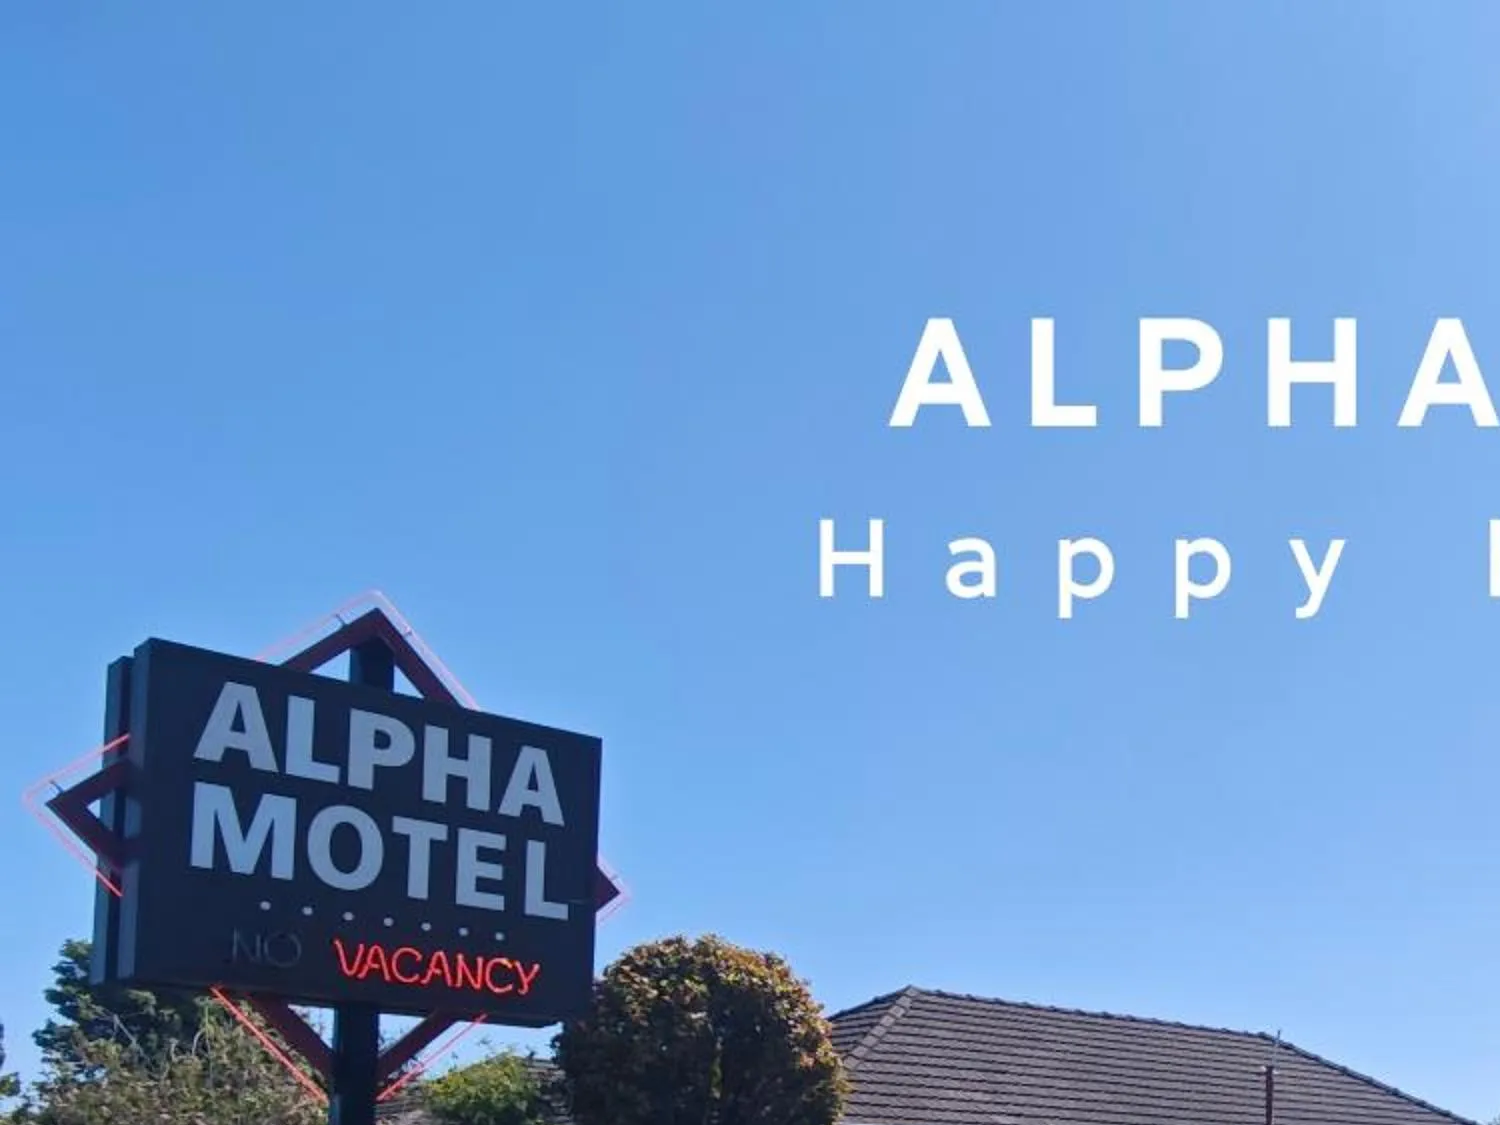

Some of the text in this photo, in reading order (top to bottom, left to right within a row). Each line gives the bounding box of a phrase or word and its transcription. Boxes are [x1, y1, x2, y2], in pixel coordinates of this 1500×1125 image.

[194, 681, 564, 826] ALPHA
[190, 781, 569, 920] MOTEL
[231, 927, 541, 995] NO VACANCY
